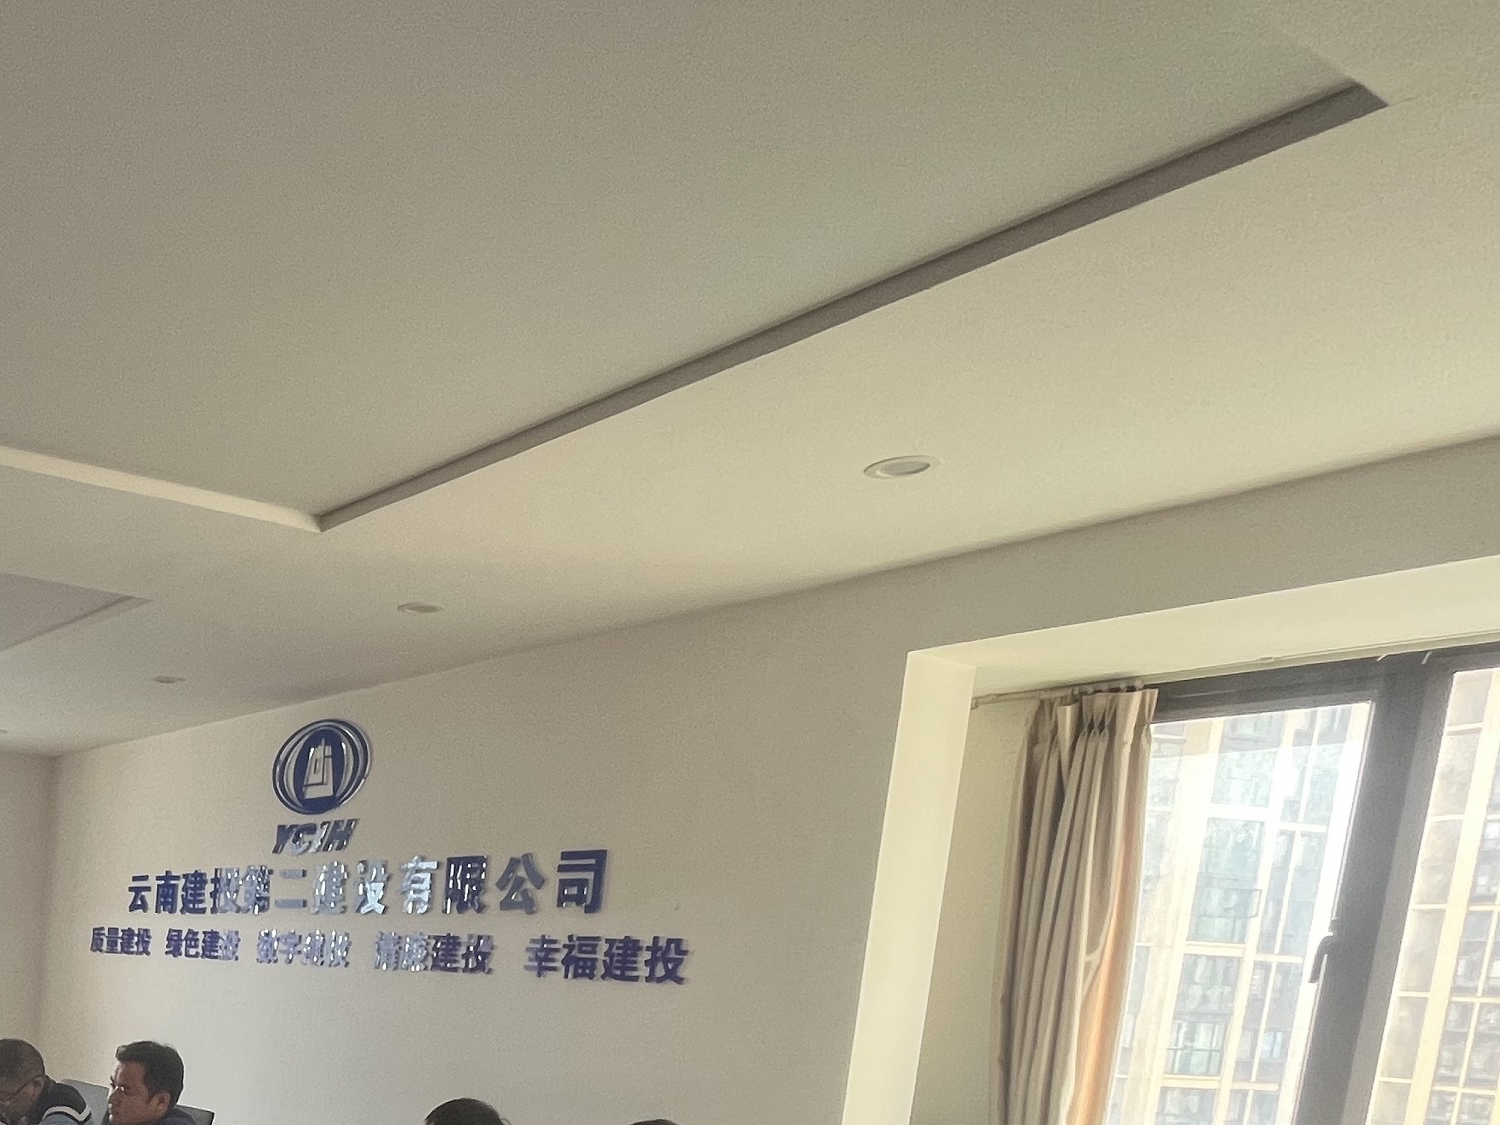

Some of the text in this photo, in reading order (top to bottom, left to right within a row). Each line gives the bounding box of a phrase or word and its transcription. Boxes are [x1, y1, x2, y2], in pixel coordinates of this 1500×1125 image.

[271, 818, 360, 857] YCIH
[127, 849, 609, 916] 云南建投第二建设有限公司
[89, 925, 152, 957] 质量建投
[164, 927, 242, 962] 绿色建投
[255, 928, 352, 968] 数字建投
[523, 932, 690, 985] 幸福建投
